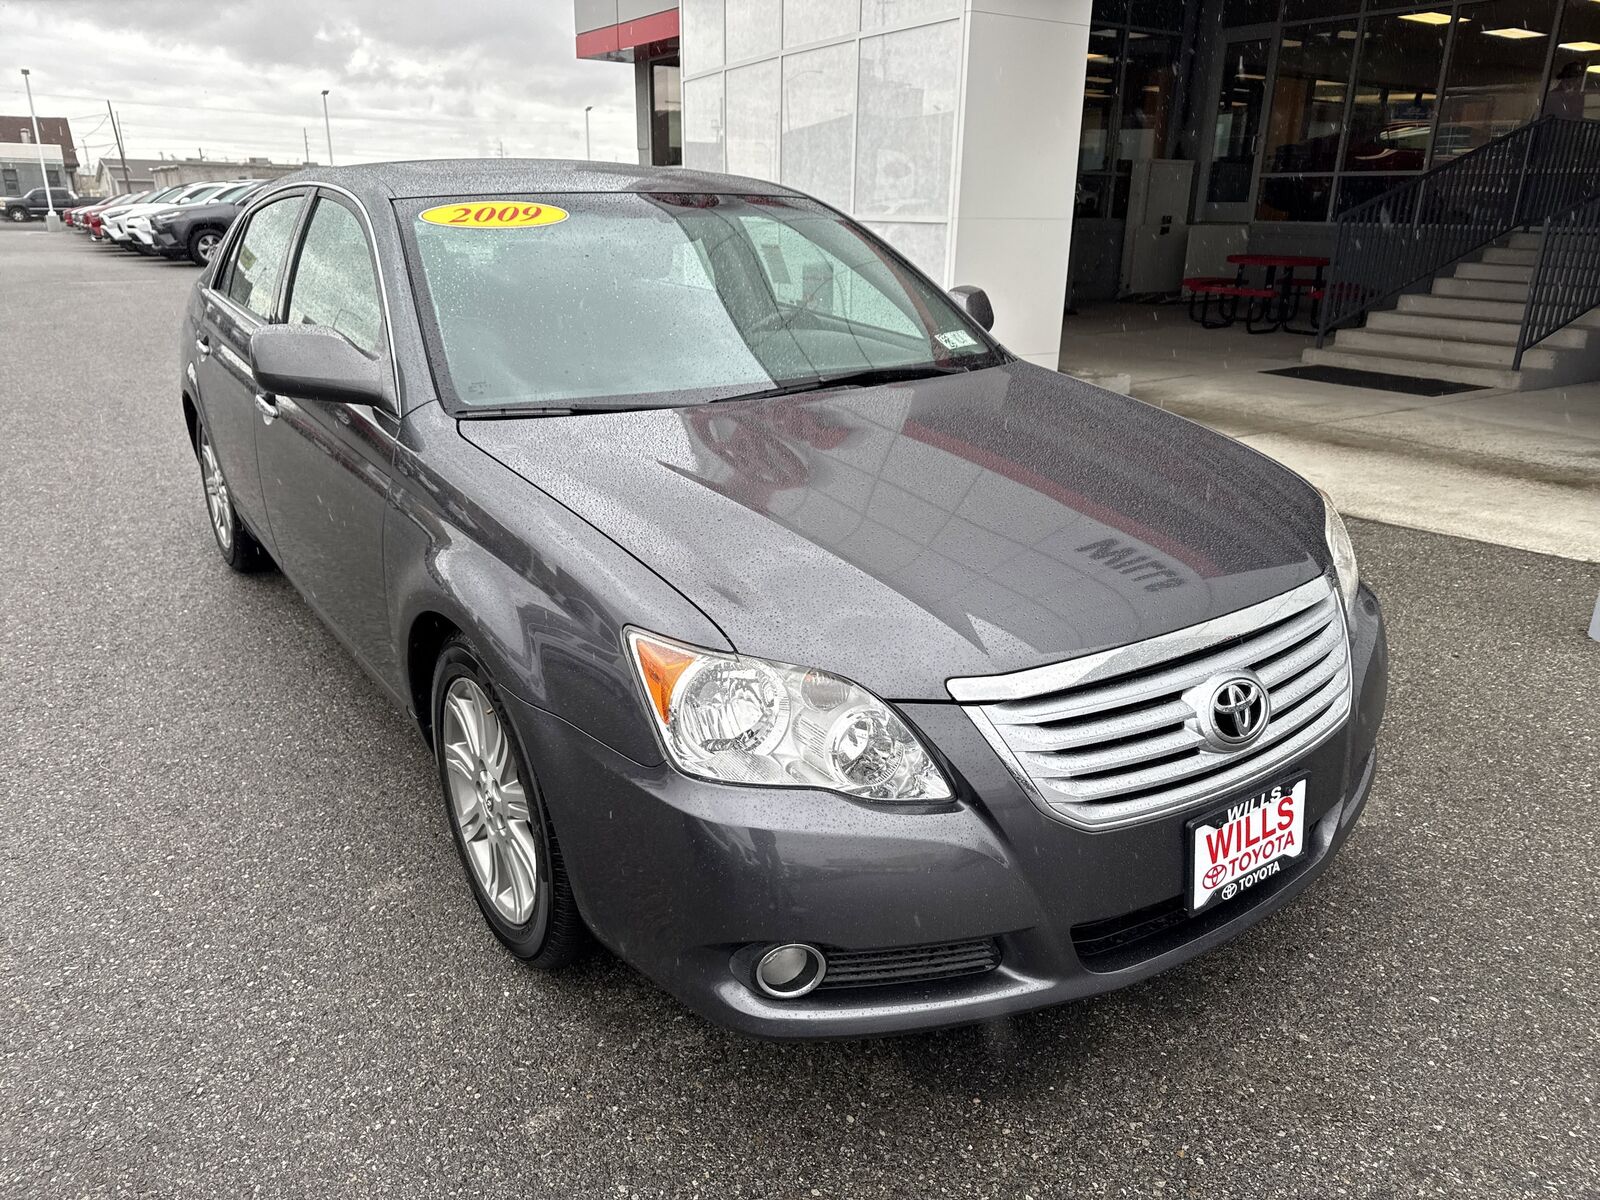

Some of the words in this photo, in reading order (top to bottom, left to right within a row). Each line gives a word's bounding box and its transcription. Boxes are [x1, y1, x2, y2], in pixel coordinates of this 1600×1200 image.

[448, 206, 542, 223] 2009
[1227, 786, 1281, 823] WILLS
[1206, 797, 1293, 864] WILLS
[1229, 831, 1294, 876] TOYOTA
[1239, 862, 1280, 891] TOYOTA
